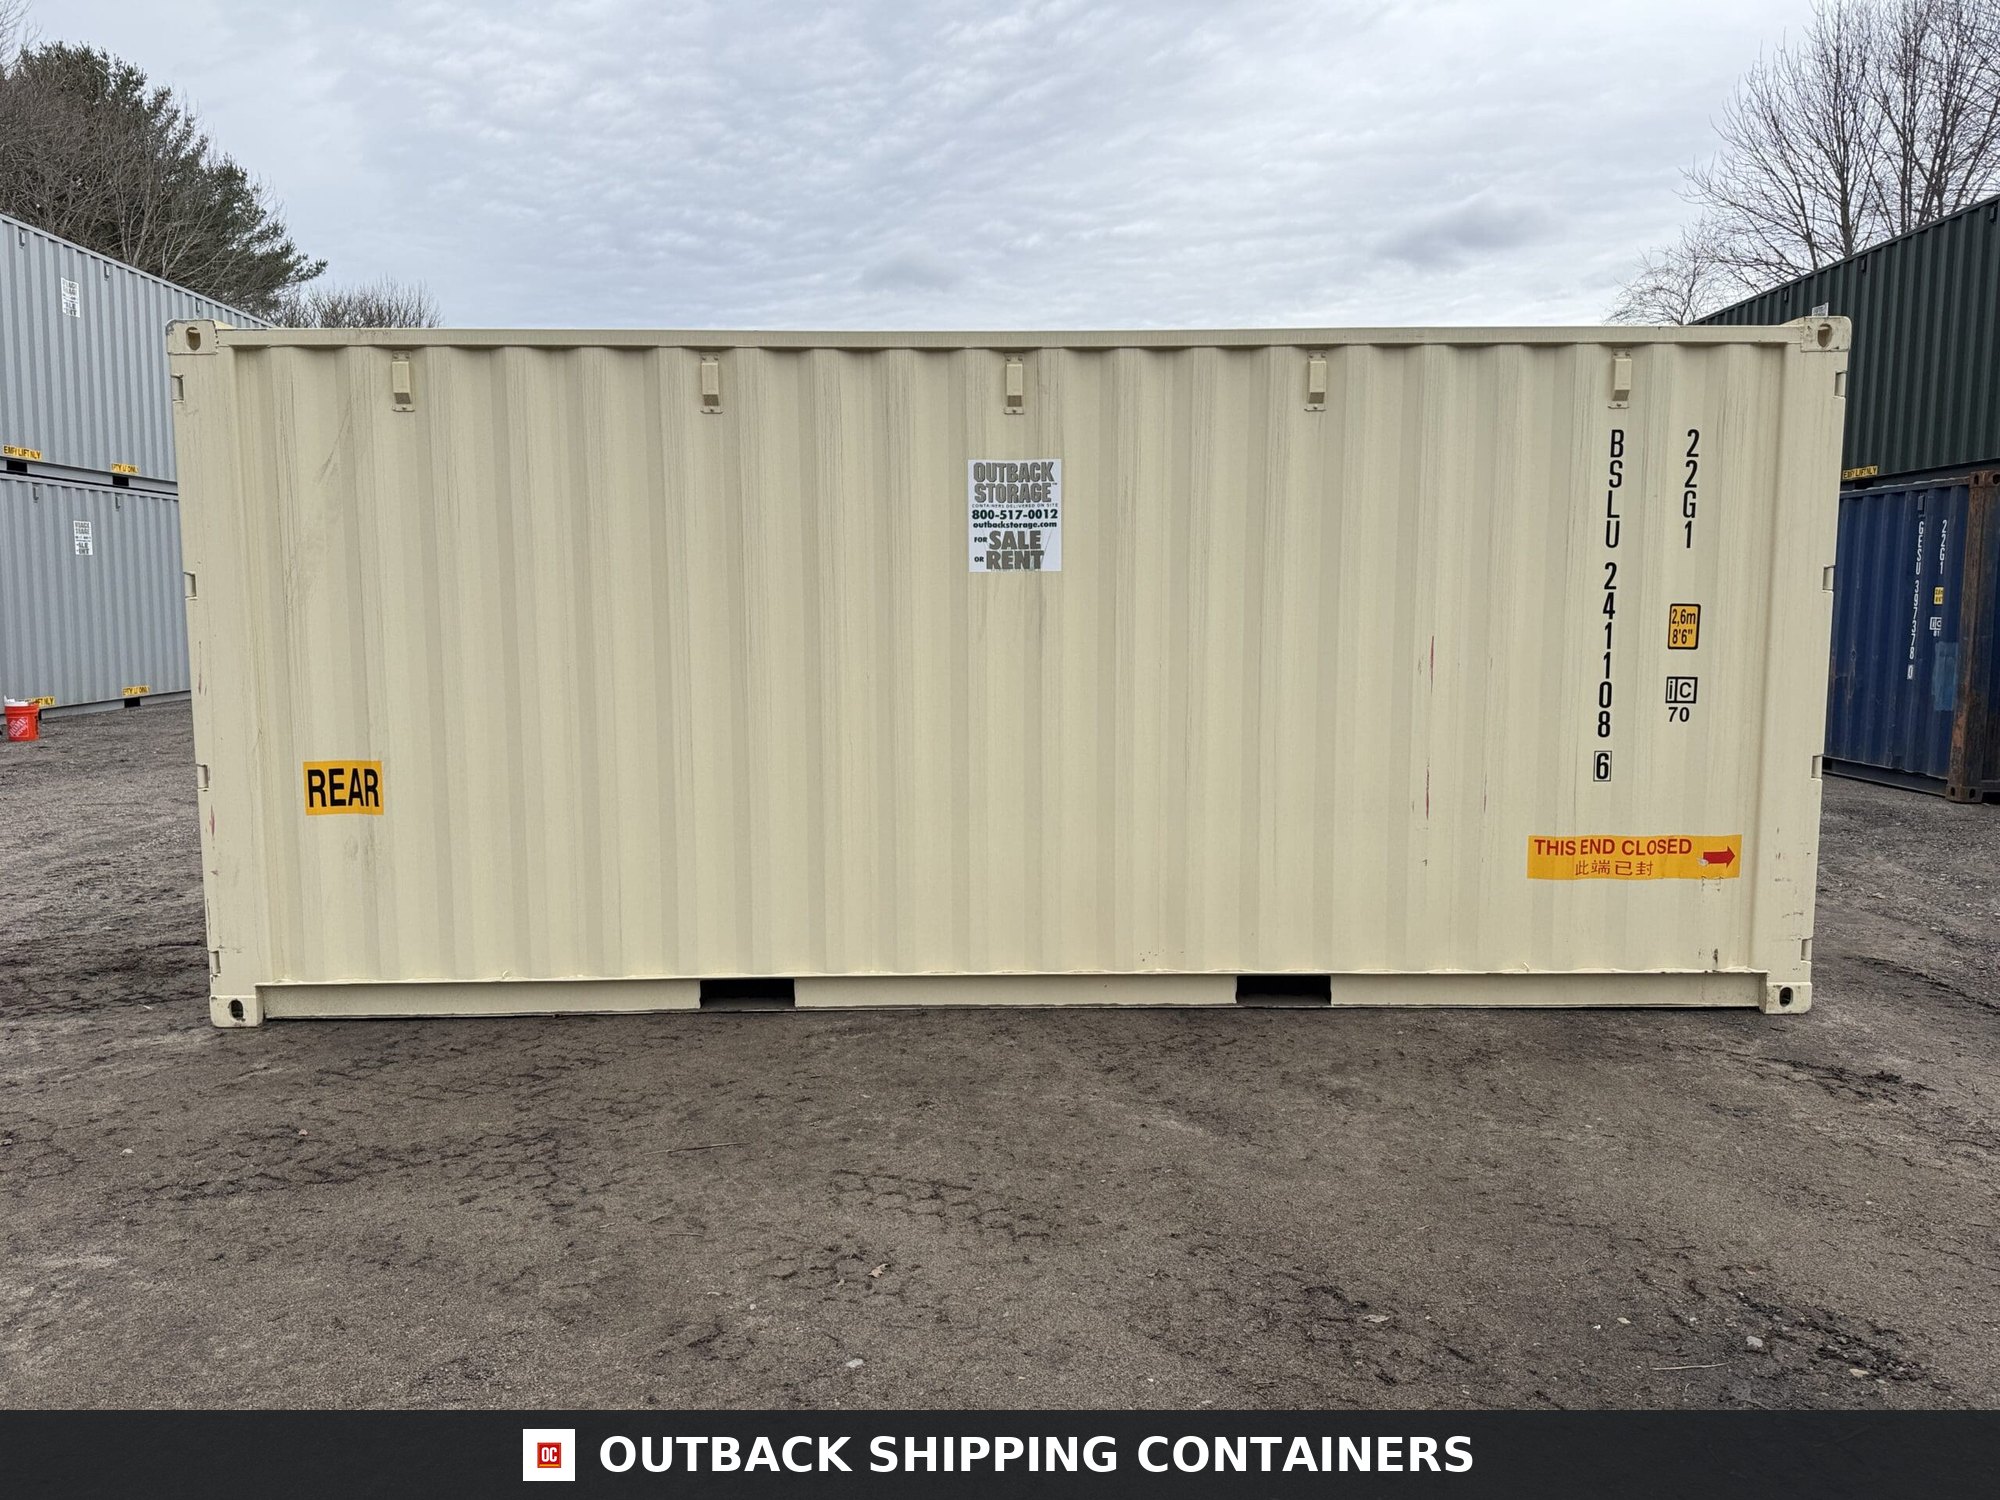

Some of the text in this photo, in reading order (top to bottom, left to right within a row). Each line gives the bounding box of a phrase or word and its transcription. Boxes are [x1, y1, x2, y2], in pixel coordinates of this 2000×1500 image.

[973, 462, 1055, 483] OUTBACK
[974, 483, 1052, 503] STORAGE
[1682, 428, 1700, 549] 22G1
[972, 509, 1058, 520] 800-517-0012
[973, 521, 1057, 529] outbackstorage.com
[989, 530, 1042, 550] SALE
[1939, 519, 1948, 575] 22G1
[986, 550, 1044, 570] RENT
[1595, 429, 1625, 780] BSLU 241108 6
[1671, 608, 1696, 627] 2,6m
[1672, 628, 1693, 645] 8'6"
[1668, 706, 1690, 723] 70
[307, 767, 380, 808] REAR
[1533, 838, 1692, 856] THIS END CLOSED
[1575, 859, 1654, 876] 此端已封
